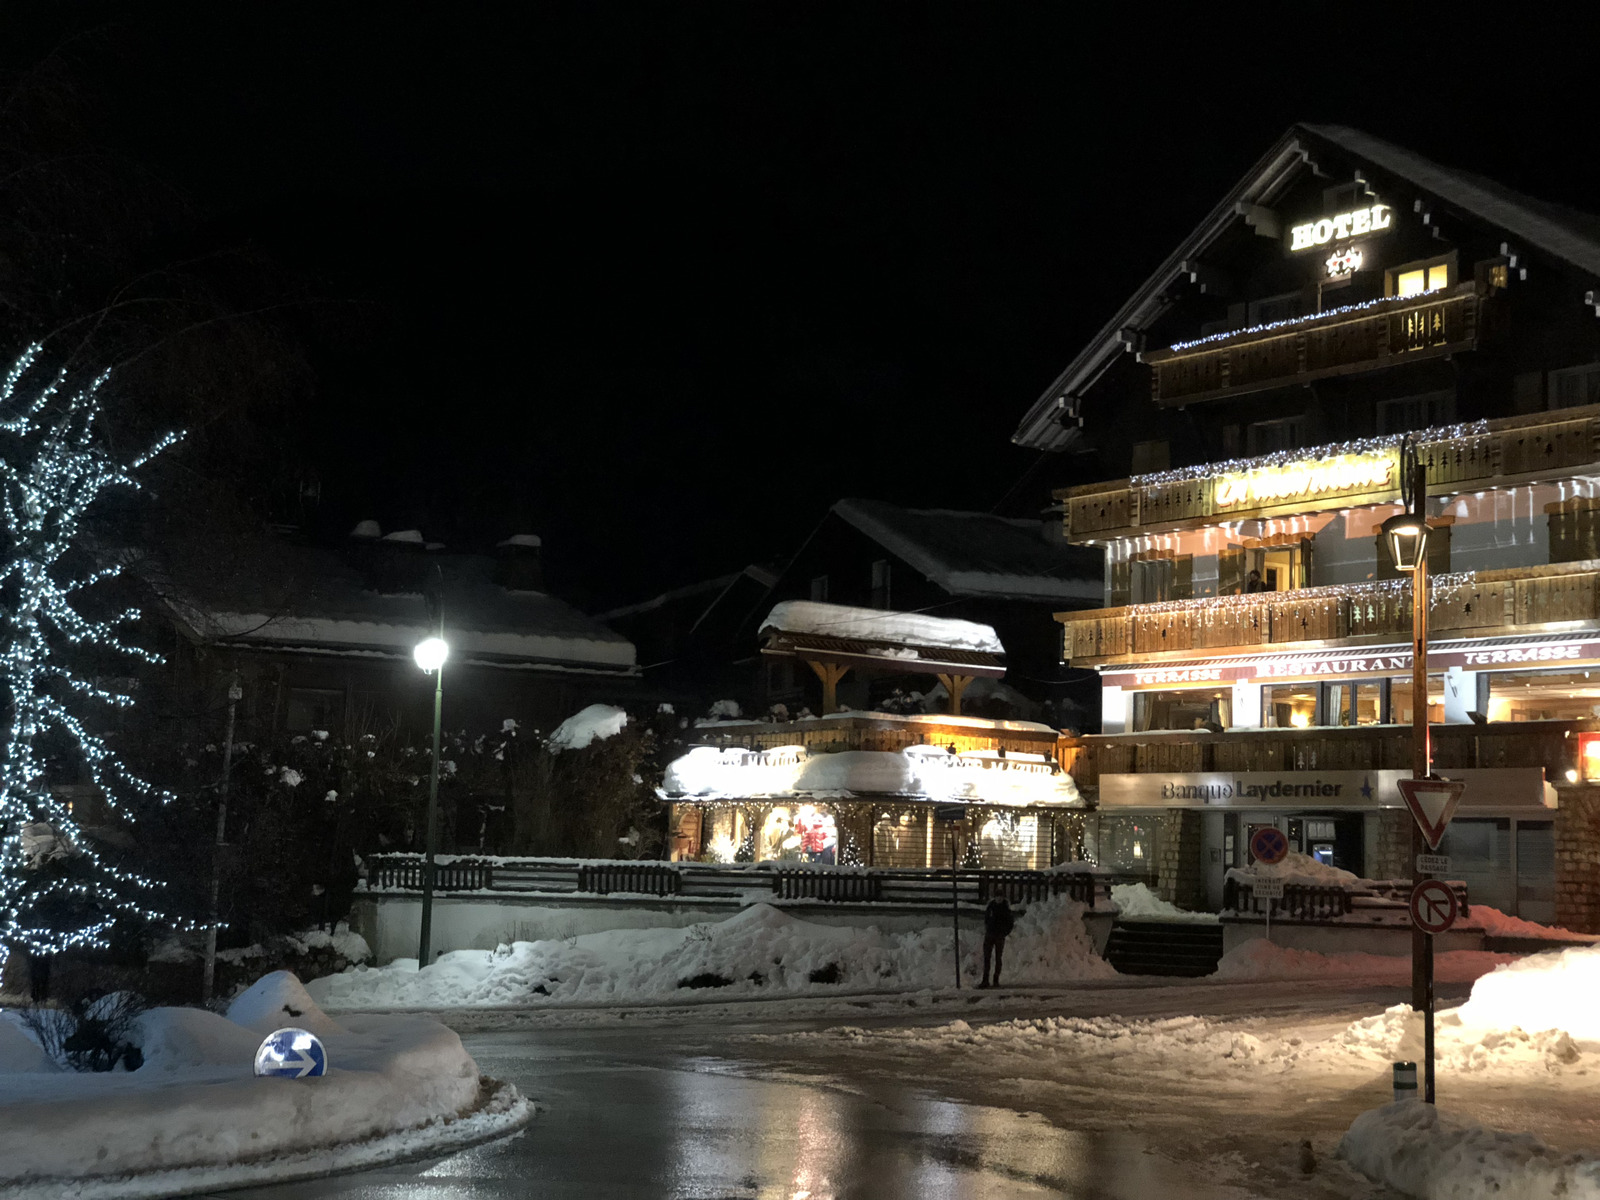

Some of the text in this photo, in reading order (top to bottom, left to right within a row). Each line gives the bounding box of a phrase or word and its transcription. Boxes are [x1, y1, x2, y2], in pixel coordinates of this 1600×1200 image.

[1290, 204, 1391, 251] HOTEL
[1464, 645, 1582, 665] TERRASSE
[1134, 669, 1222, 685] TERRASSE
[1161, 780, 1342, 803] Banque Laydernier
